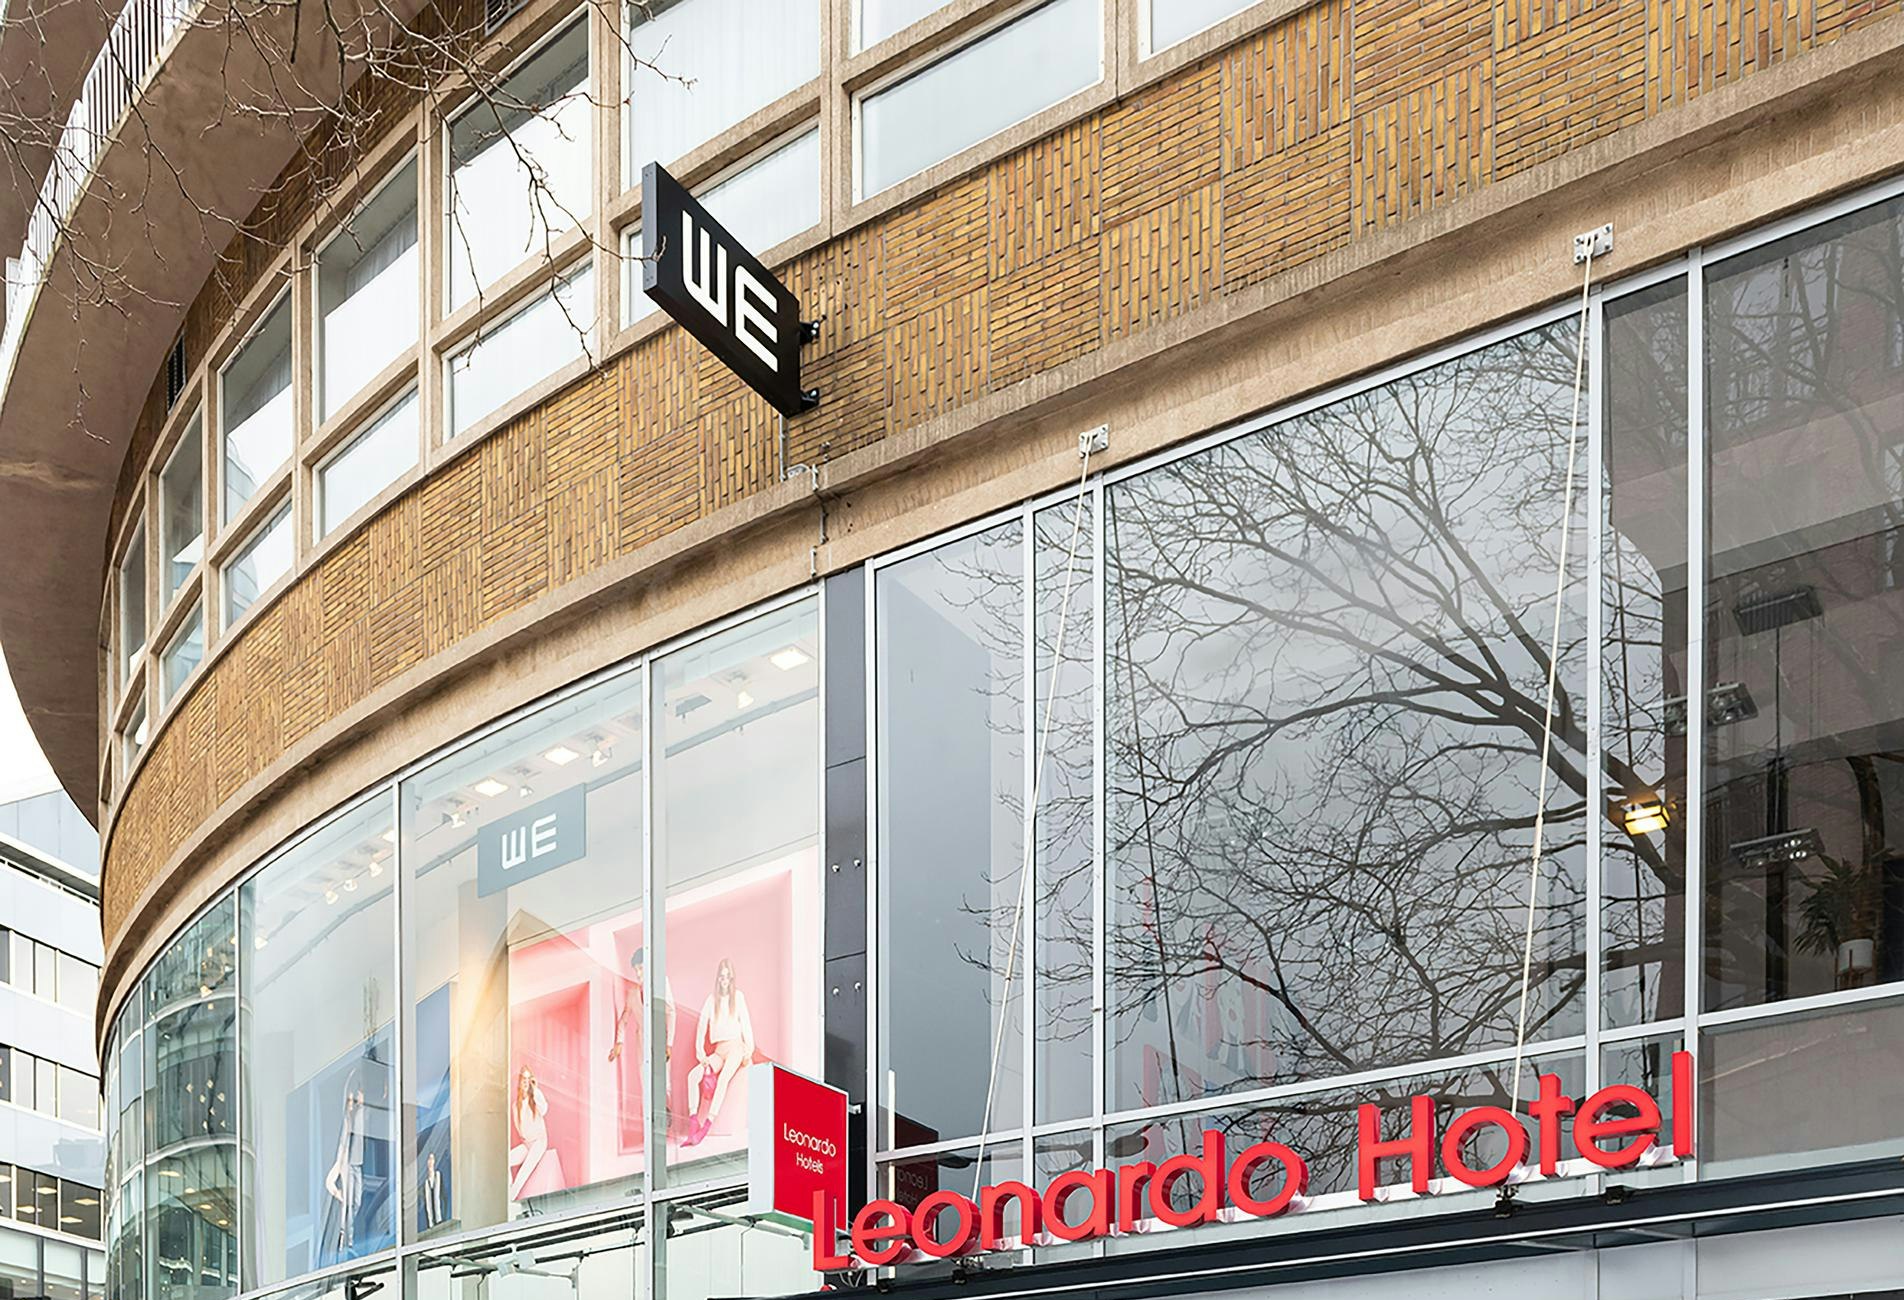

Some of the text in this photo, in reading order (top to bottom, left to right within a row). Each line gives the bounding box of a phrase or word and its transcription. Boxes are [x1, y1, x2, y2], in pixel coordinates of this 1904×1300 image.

[682, 210, 778, 373] WE
[501, 813, 557, 870] WE
[783, 1122, 837, 1158] Leonardo
[796, 1152, 825, 1175] Hotels
[813, 1051, 1695, 1272] Leonardo Hotel
